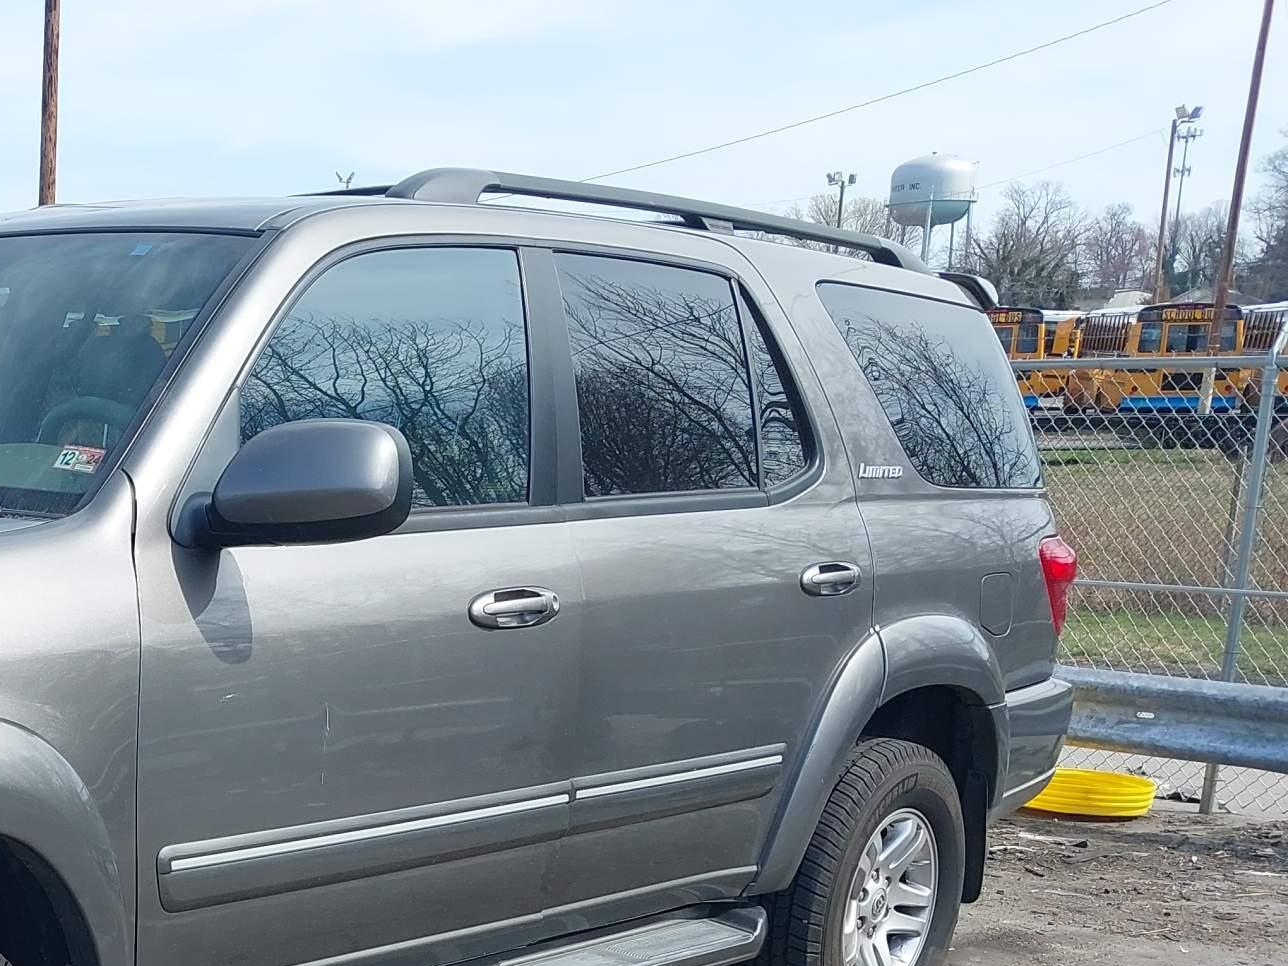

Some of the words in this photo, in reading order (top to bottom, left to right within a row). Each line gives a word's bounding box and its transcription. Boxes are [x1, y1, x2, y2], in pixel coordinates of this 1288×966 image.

[909, 182, 921, 190] INC
[1006, 312, 1022, 323] BUS
[1165, 309, 1194, 321] SCHOOL
[1199, 308, 1215, 320] BU
[60, 451, 77, 466] 12
